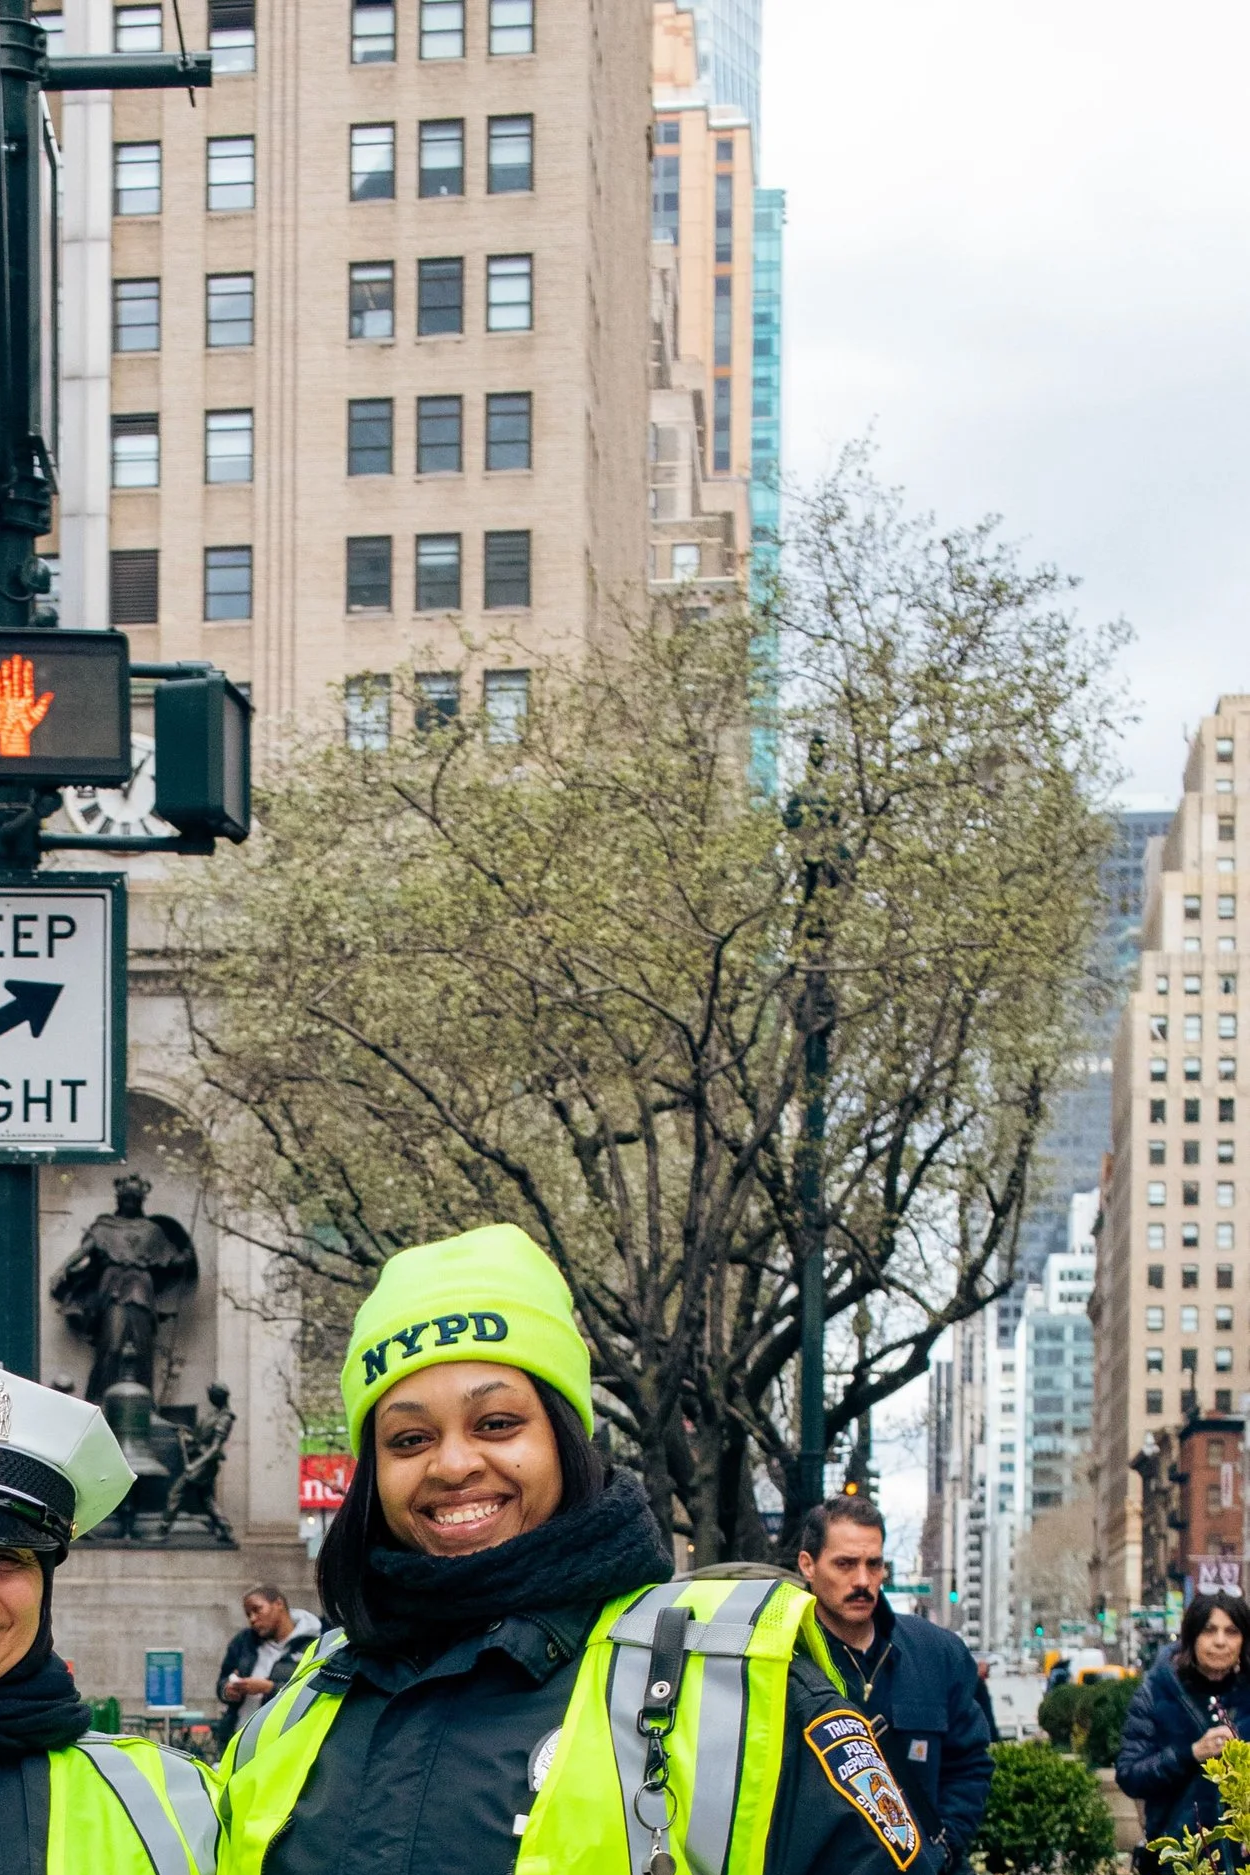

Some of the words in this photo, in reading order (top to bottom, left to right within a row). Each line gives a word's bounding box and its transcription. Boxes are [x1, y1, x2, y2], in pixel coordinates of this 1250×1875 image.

[361, 1311, 509, 1386] NYPD
[823, 1718, 868, 1739] TRAFFIC
[855, 1795, 883, 1824] CITY
[883, 1826, 897, 1844] OF
